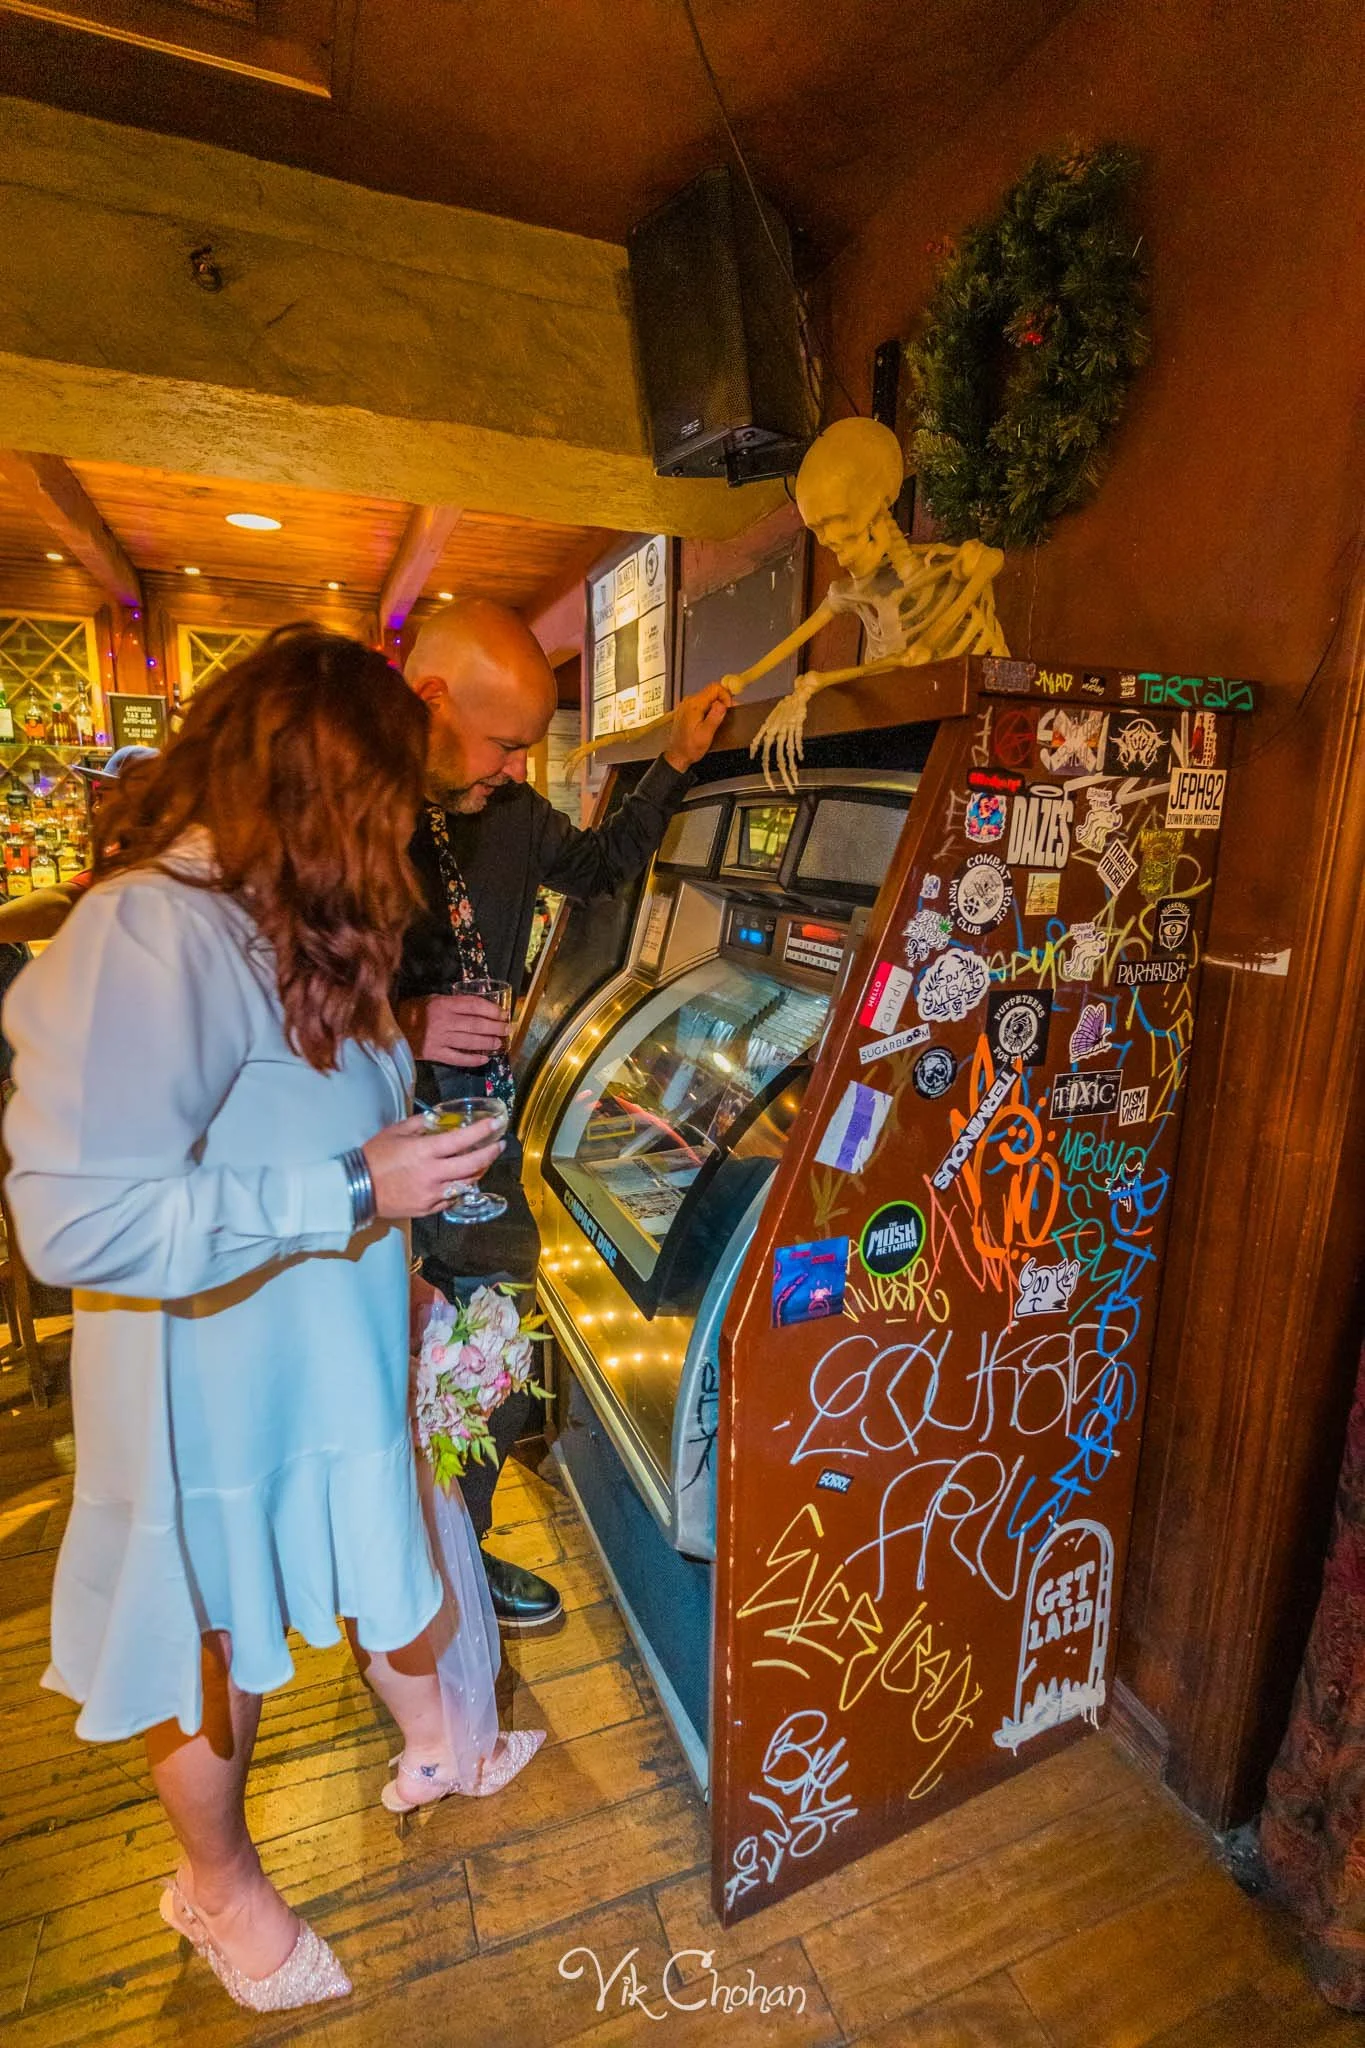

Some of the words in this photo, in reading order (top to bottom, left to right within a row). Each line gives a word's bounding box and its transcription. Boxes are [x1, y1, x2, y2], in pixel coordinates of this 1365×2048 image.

[1171, 772, 1223, 811] JEPH92
[1007, 796, 1074, 867] DAZES
[966, 853, 1012, 881] COMBAT
[1101, 856, 1126, 890] MUSIC
[993, 885, 1014, 926] ROCK
[956, 917, 982, 936] CLUB
[867, 980, 882, 1008] HELLO
[944, 970, 960, 983] DJ
[994, 995, 1046, 1021] PUPPETEERS
[861, 1028, 930, 1062] SUGARBLOOM
[933, 1071, 1018, 1190] TERMINOUS
[1121, 1105, 1145, 1123] VISTA
[563, 1189, 598, 1240] COMPACT
[596, 1231, 617, 1268] DISC
[866, 1216, 917, 1260] MOSH
[1036, 1560, 1096, 1615] GET
[1028, 1599, 1094, 1650] LAID
